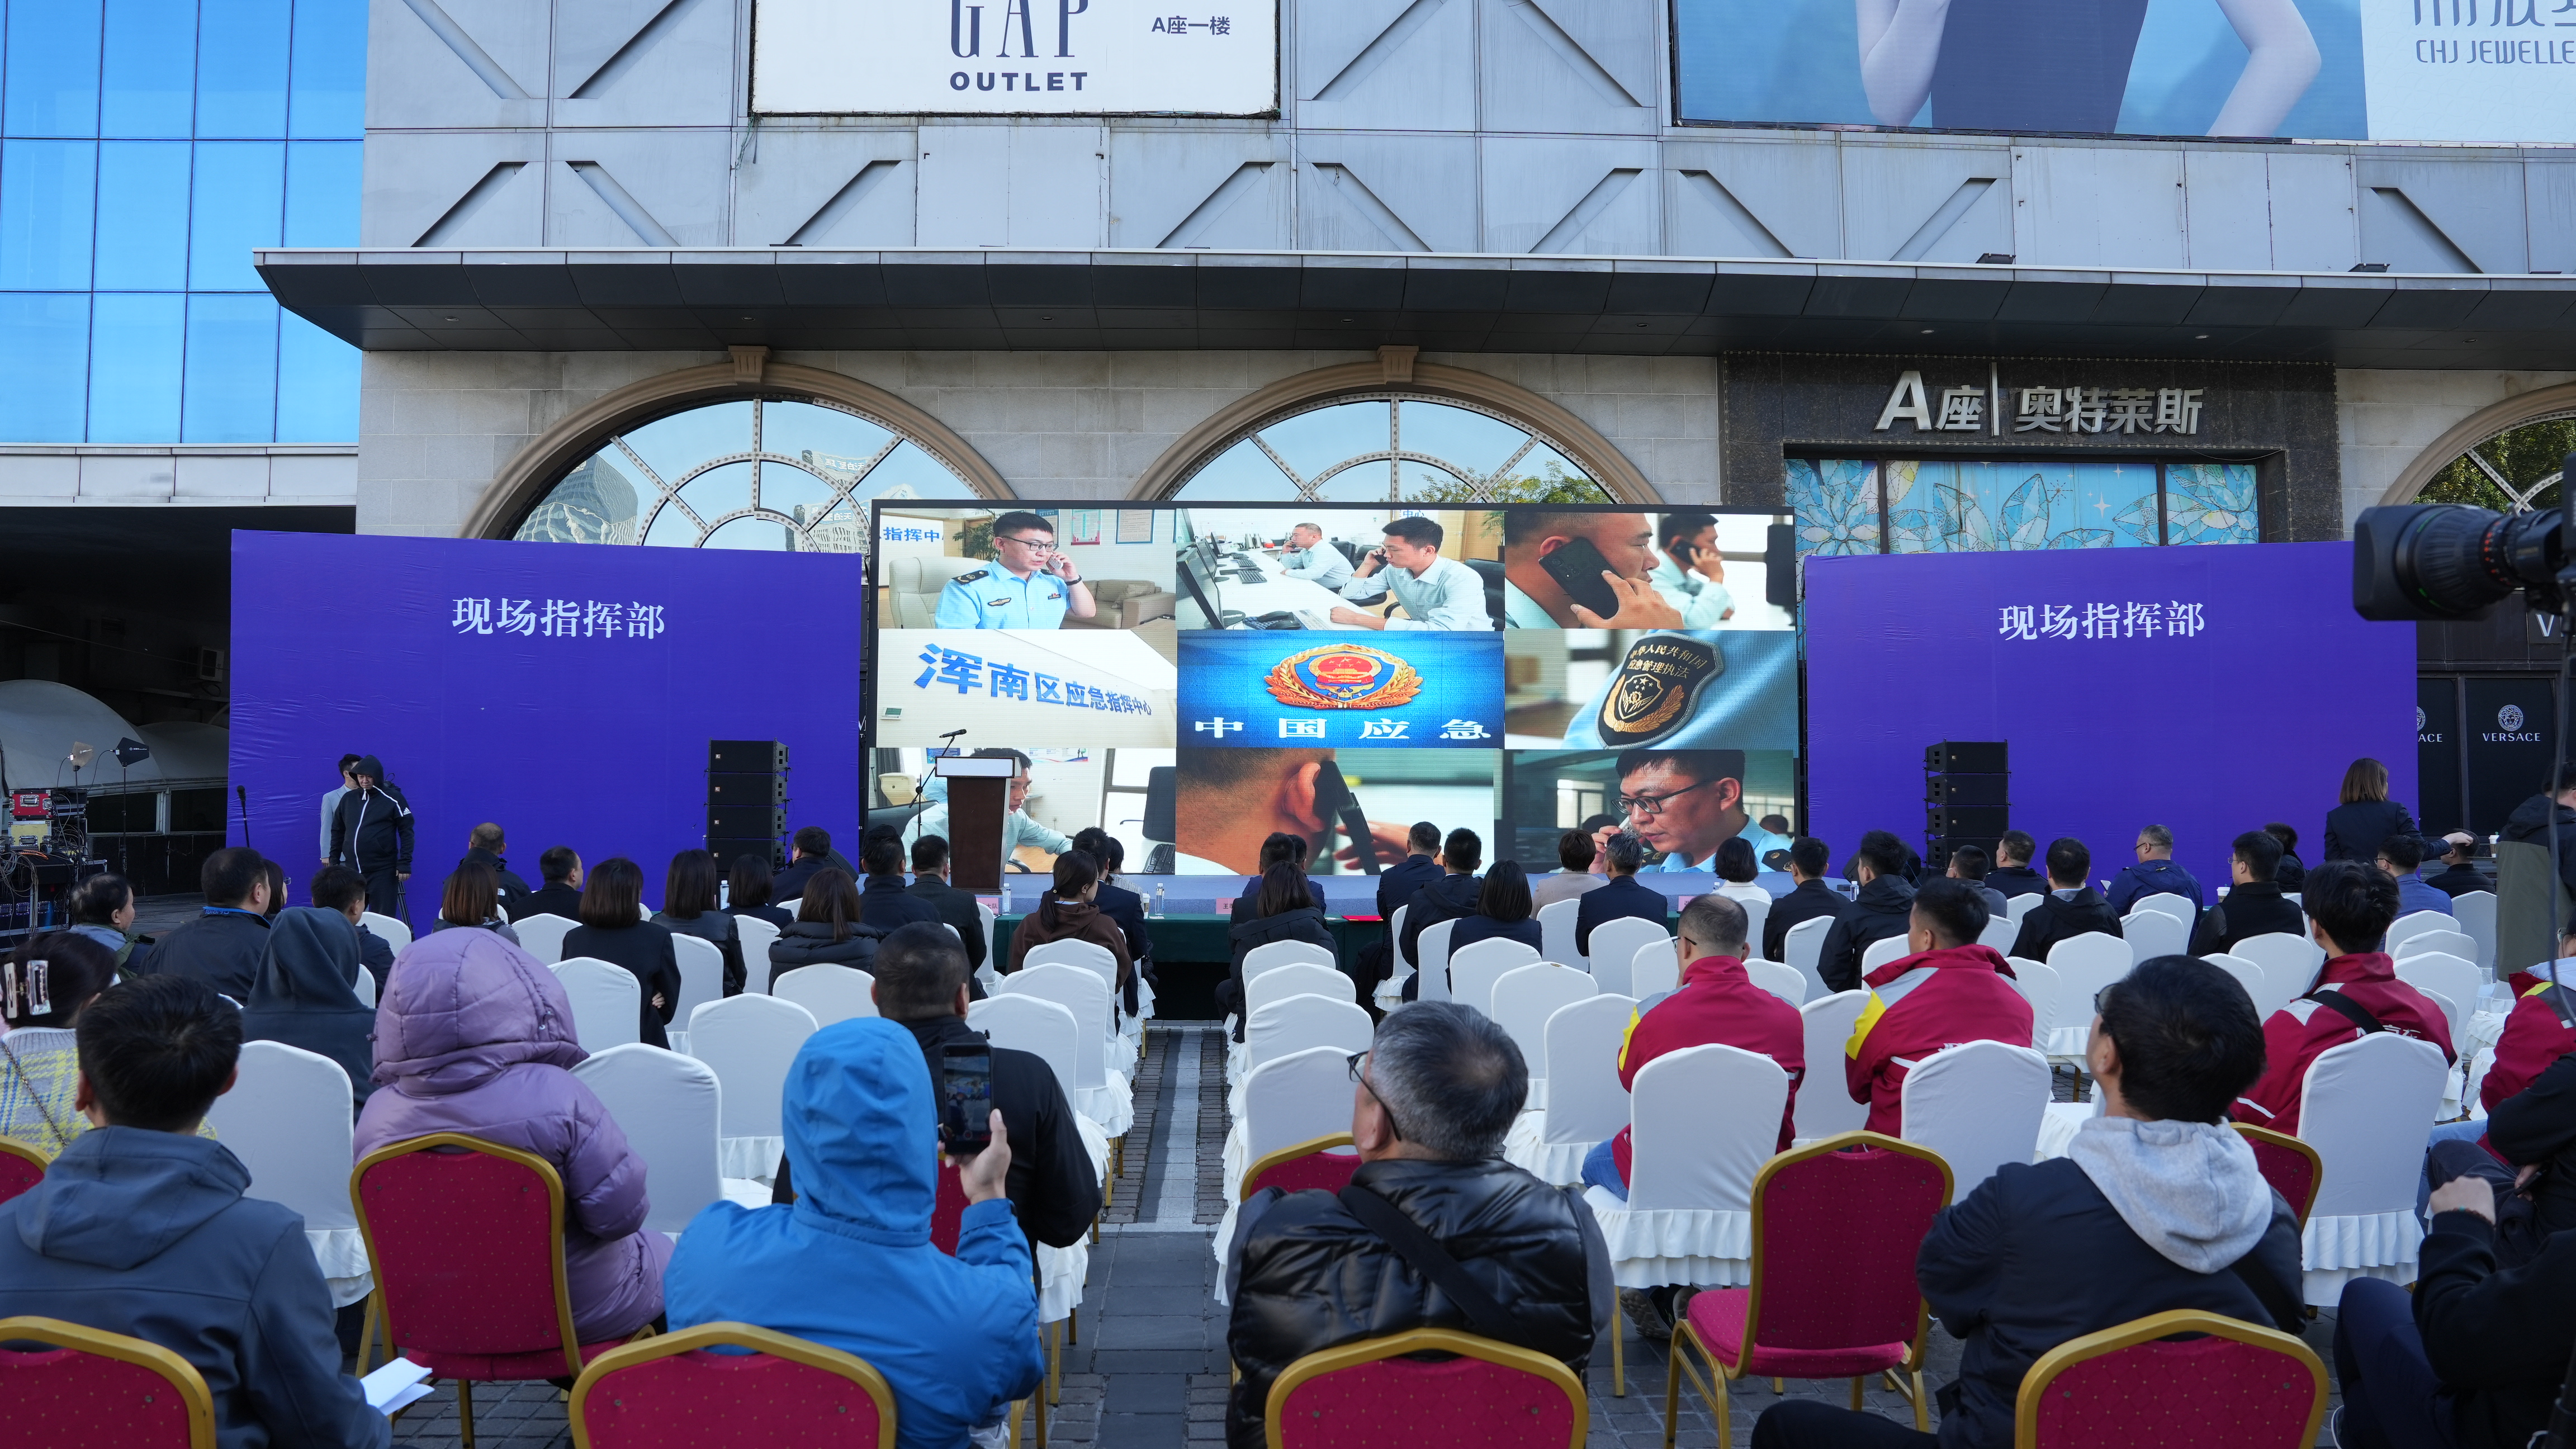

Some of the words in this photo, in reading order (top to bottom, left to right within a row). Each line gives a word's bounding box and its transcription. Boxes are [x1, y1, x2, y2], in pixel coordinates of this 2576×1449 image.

[951, 0, 1088, 58] GAP
[1152, 16, 1230, 35] A座一楼
[2416, 40, 2458, 63] CHJ
[2467, 40, 2575, 64] JEWELLE
[950, 72, 1087, 91] OUTLET
[1874, 370, 1985, 431] A座
[2014, 385, 2204, 435] 奥特莱斯
[880, 527, 944, 542] 指挥中
[452, 597, 665, 639] 现场指挥部
[1999, 600, 2205, 641] 现场指挥部
[1629, 644, 1707, 669] 中华人民共和国
[914, 643, 1152, 715] 浑南区应急指挥中心
[1627, 659, 1690, 679] 应急管理执法
[1195, 717, 1491, 740] 中国应急
[2482, 733, 2541, 742] VERSACE
